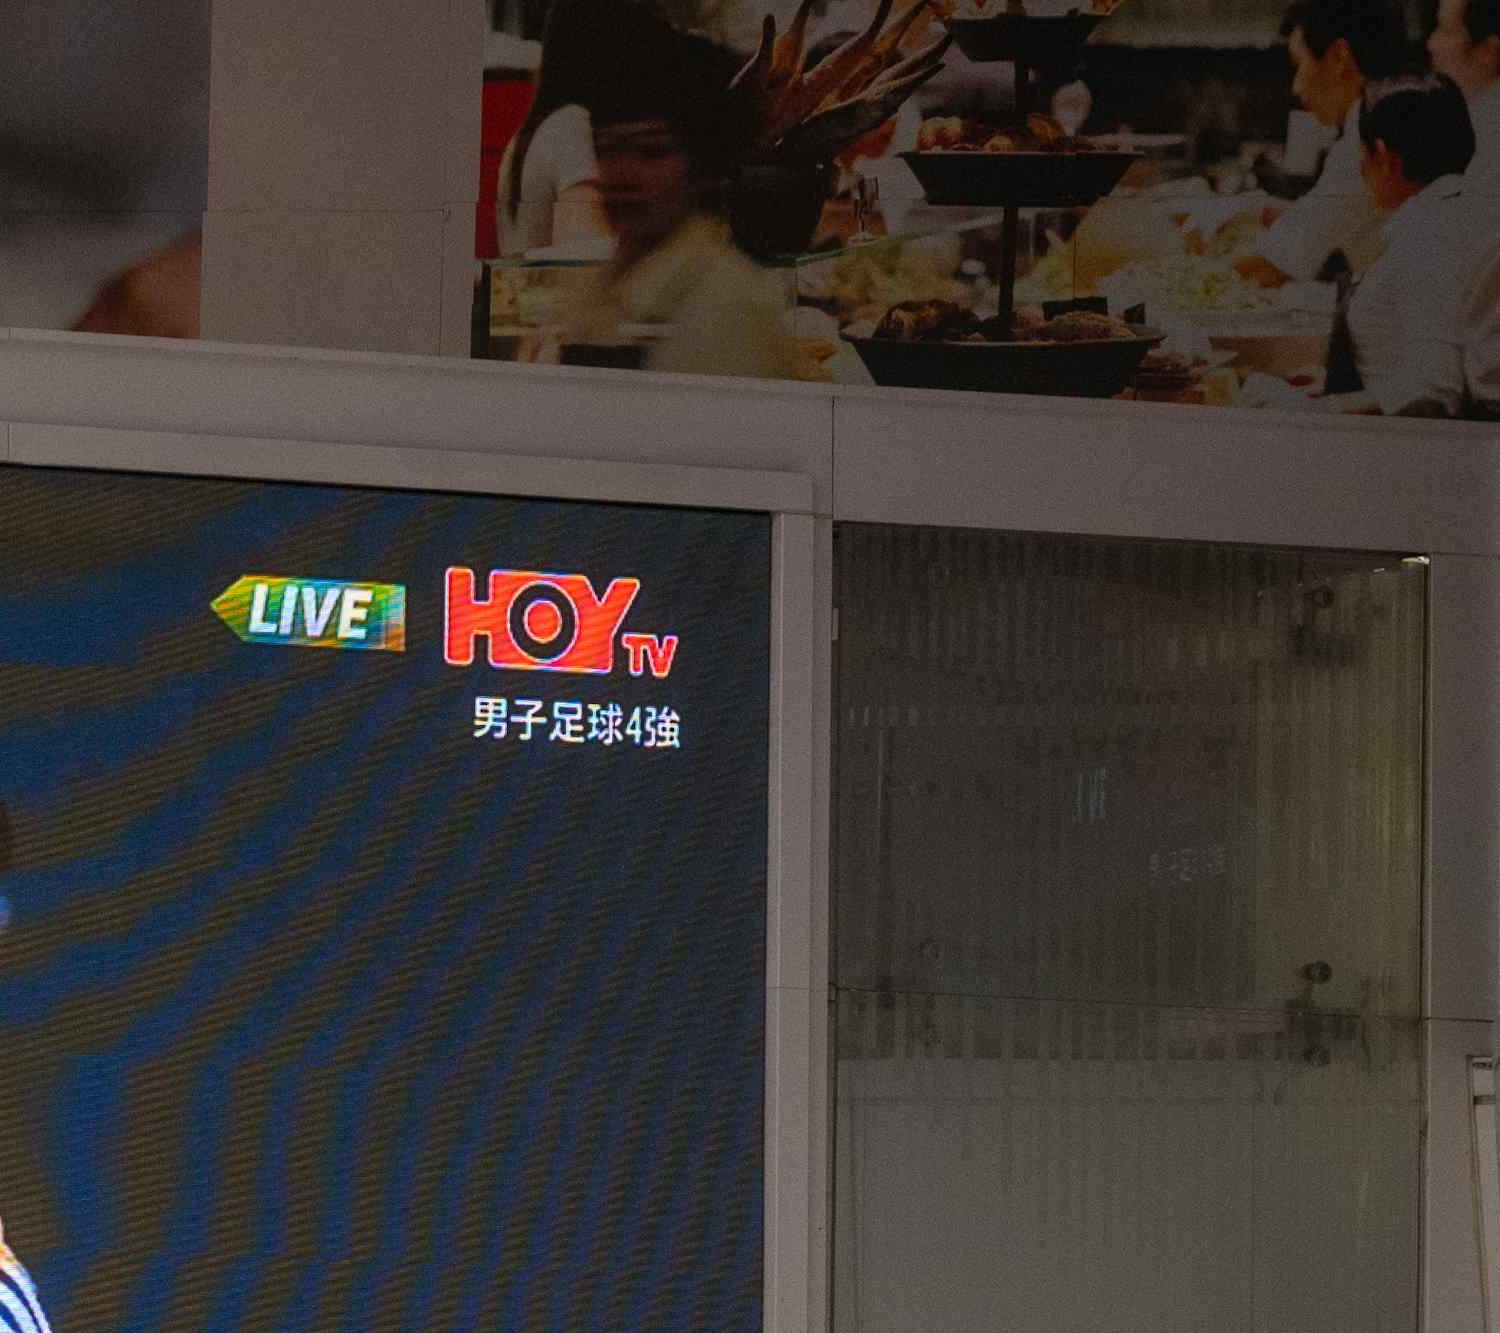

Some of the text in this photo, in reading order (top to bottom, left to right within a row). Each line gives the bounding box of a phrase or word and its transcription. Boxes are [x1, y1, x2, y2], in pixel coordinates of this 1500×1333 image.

[248, 582, 374, 640] LIVE
[444, 566, 679, 678] HOY TV
[473, 696, 682, 748] 男子足球4強
